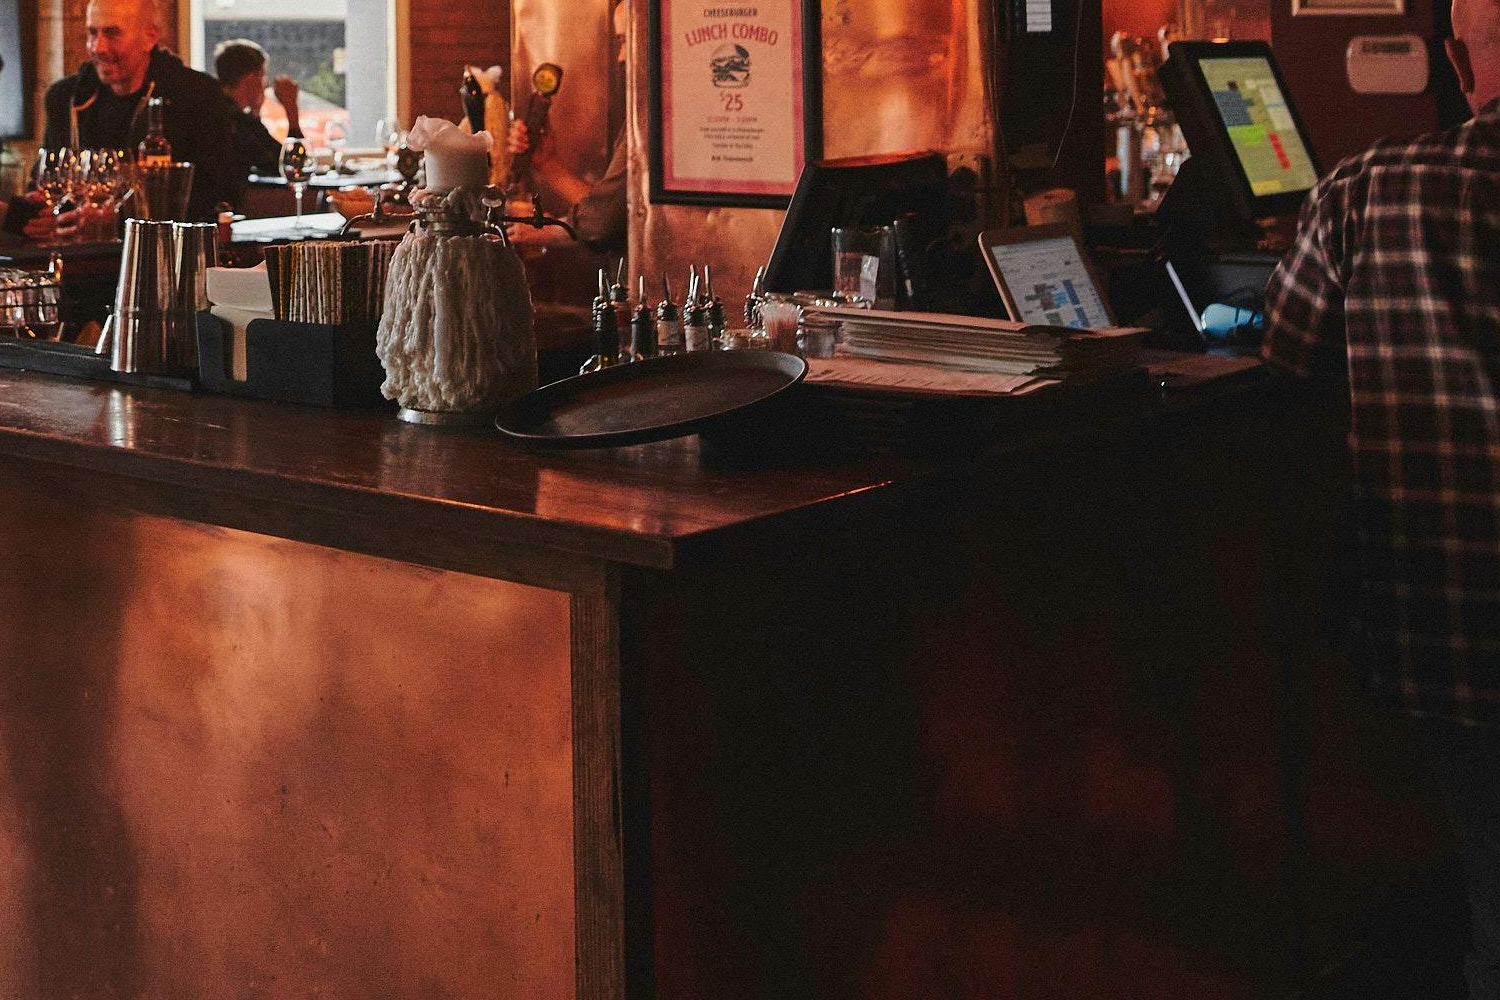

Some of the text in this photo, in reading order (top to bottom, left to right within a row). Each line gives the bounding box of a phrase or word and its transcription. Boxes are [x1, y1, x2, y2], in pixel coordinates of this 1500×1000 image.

[703, 7, 758, 18] CHEESEBURGER
[685, 23, 779, 47] LUNCH COMBO
[720, 92, 744, 112] $25
